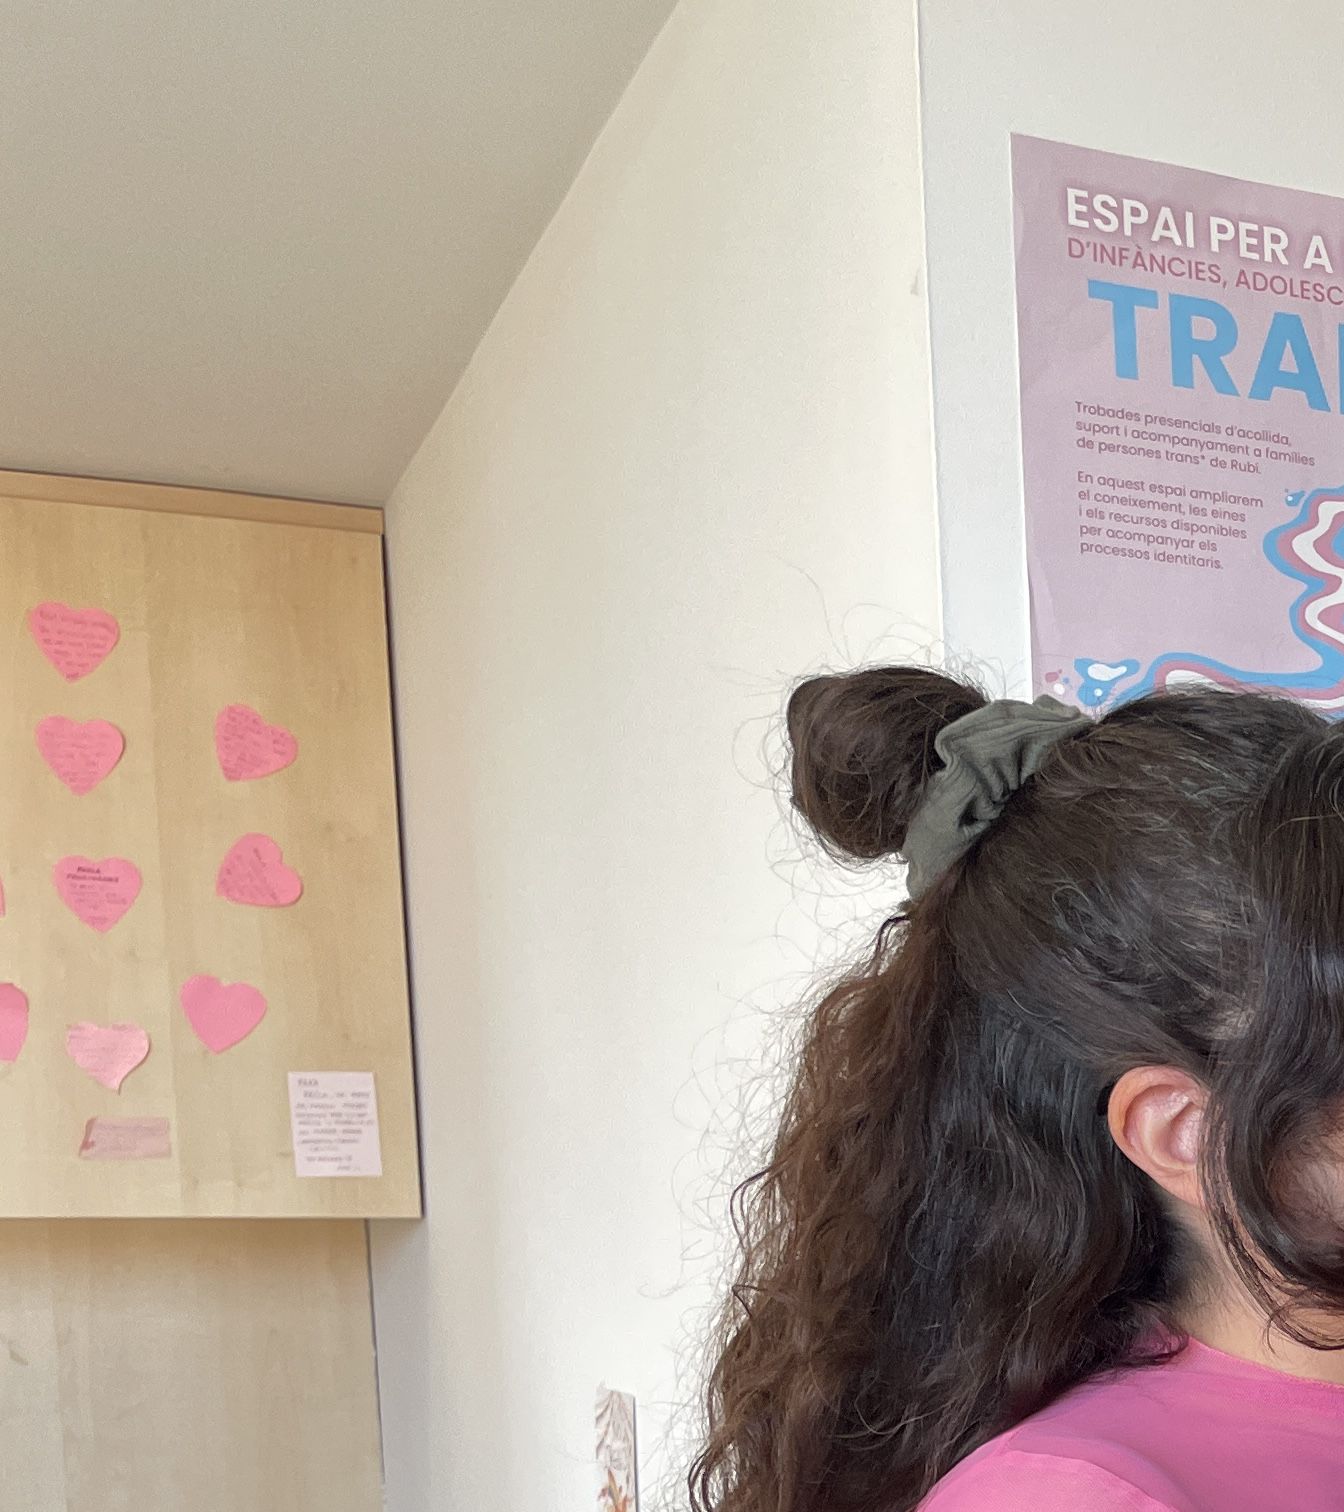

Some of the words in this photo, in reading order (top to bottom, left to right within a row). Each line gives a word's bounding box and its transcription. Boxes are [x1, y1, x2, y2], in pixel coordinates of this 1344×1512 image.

[1065, 187, 1195, 250] ESPAI
[1209, 215, 1289, 266] PER
[1303, 235, 1334, 275] A
[1067, 237, 1229, 290] D'INFÀNCIES,
[1075, 401, 1141, 423] Trobades
[1144, 412, 1222, 435] presencials
[1075, 419, 1121, 436] suport
[1131, 431, 1250, 457] acompanyament
[1253, 447, 1262, 458] a
[1076, 437, 1095, 450] de
[1098, 441, 1162, 460] persones
[1209, 455, 1228, 469] de
[1077, 470, 1094, 485] En
[1097, 475, 1145, 493] aquest
[1149, 483, 1187, 499] espai
[1189, 488, 1264, 508] ampliarem
[1078, 489, 1091, 501] el
[1093, 493, 1186, 516] coneixement,
[1189, 504, 1208, 518] les
[1211, 508, 1247, 523] eines
[1079, 524, 1102, 539] per
[1105, 528, 1196, 551] acompanyar
[1199, 538, 1218, 552] els
[1085, 508, 1105, 521] els
[1108, 513, 1168, 529] recursos
[1170, 518, 1248, 540] disponibles
[1080, 541, 1150, 561] processos
[1153, 548, 1224, 570] identitaris.
